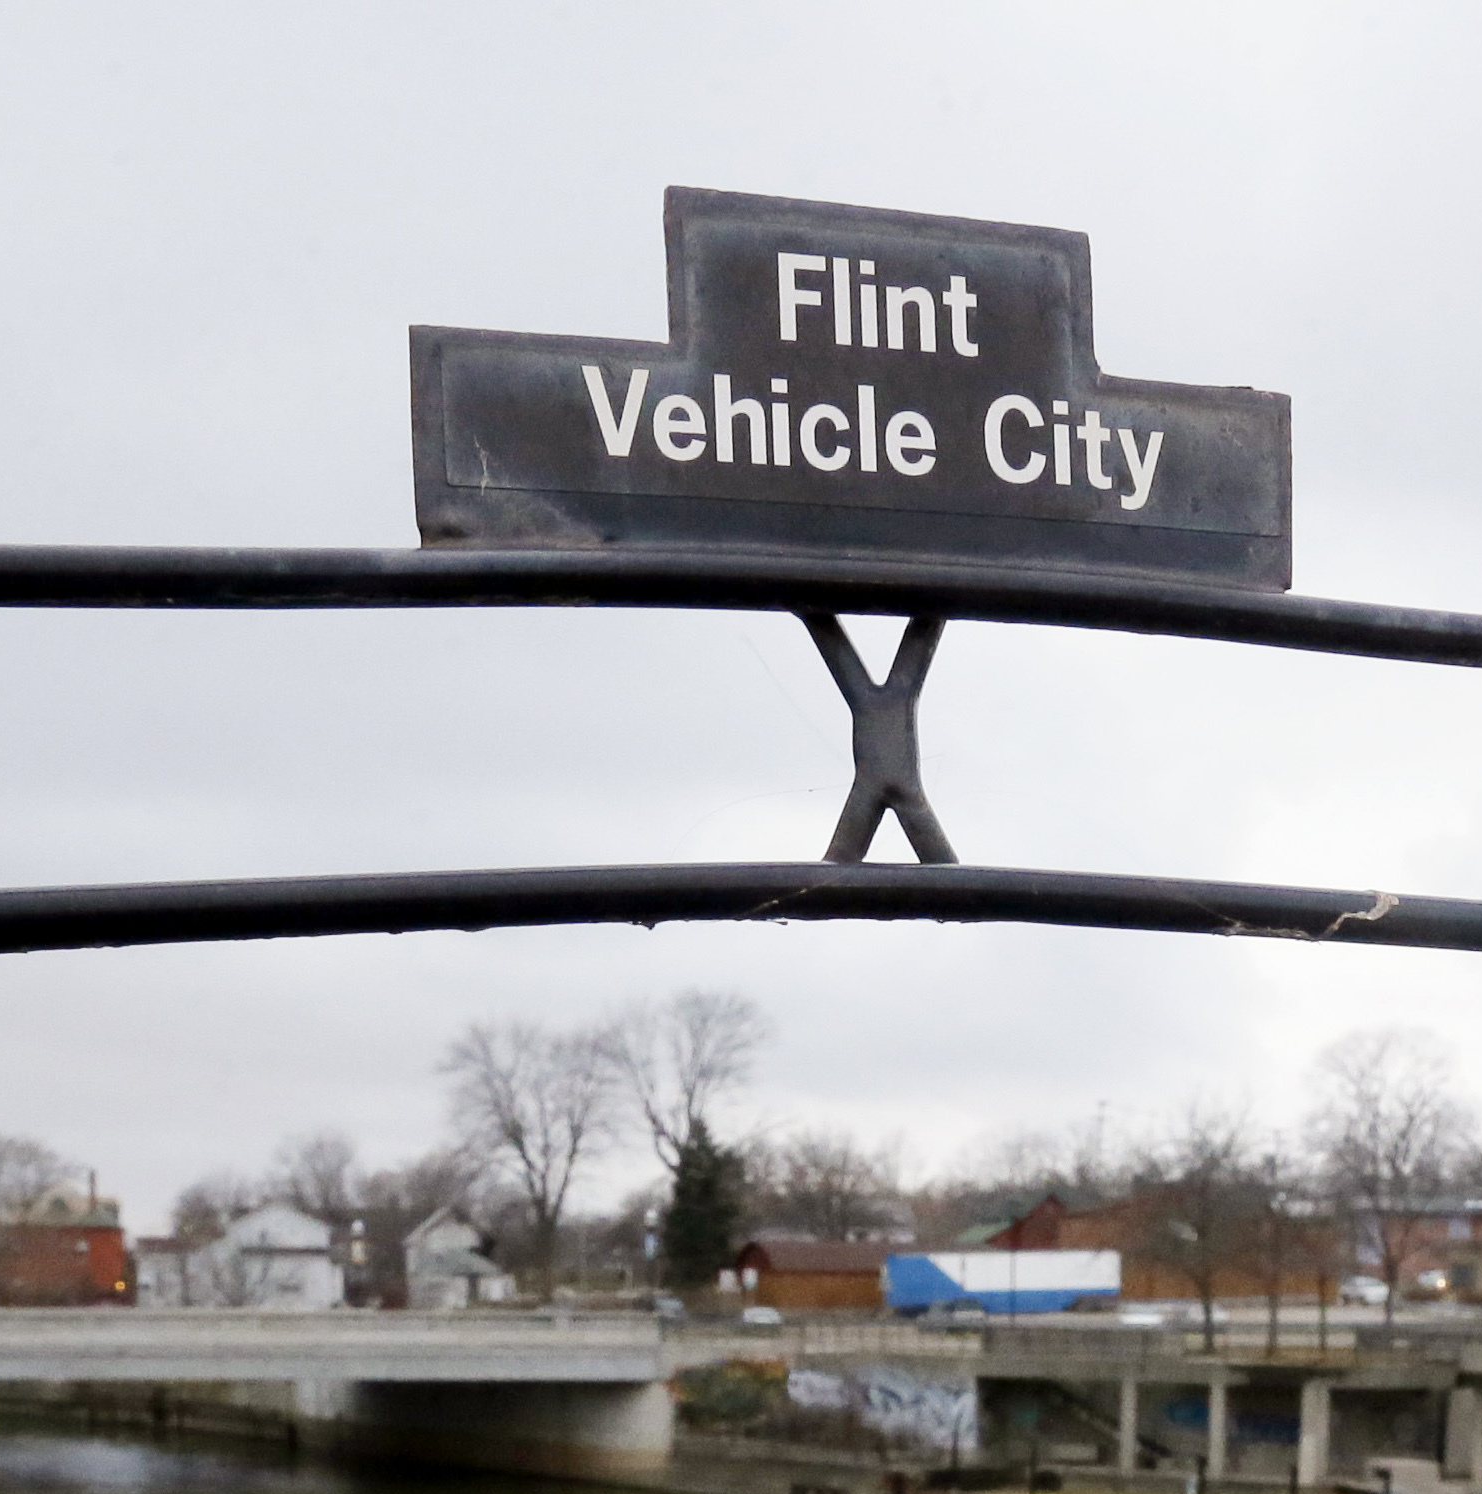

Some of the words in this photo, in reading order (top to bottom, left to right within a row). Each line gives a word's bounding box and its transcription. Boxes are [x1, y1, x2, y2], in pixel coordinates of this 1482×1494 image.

[776, 250, 980, 359] Flint
[580, 363, 938, 478] Vehicle
[983, 393, 1166, 512] City
